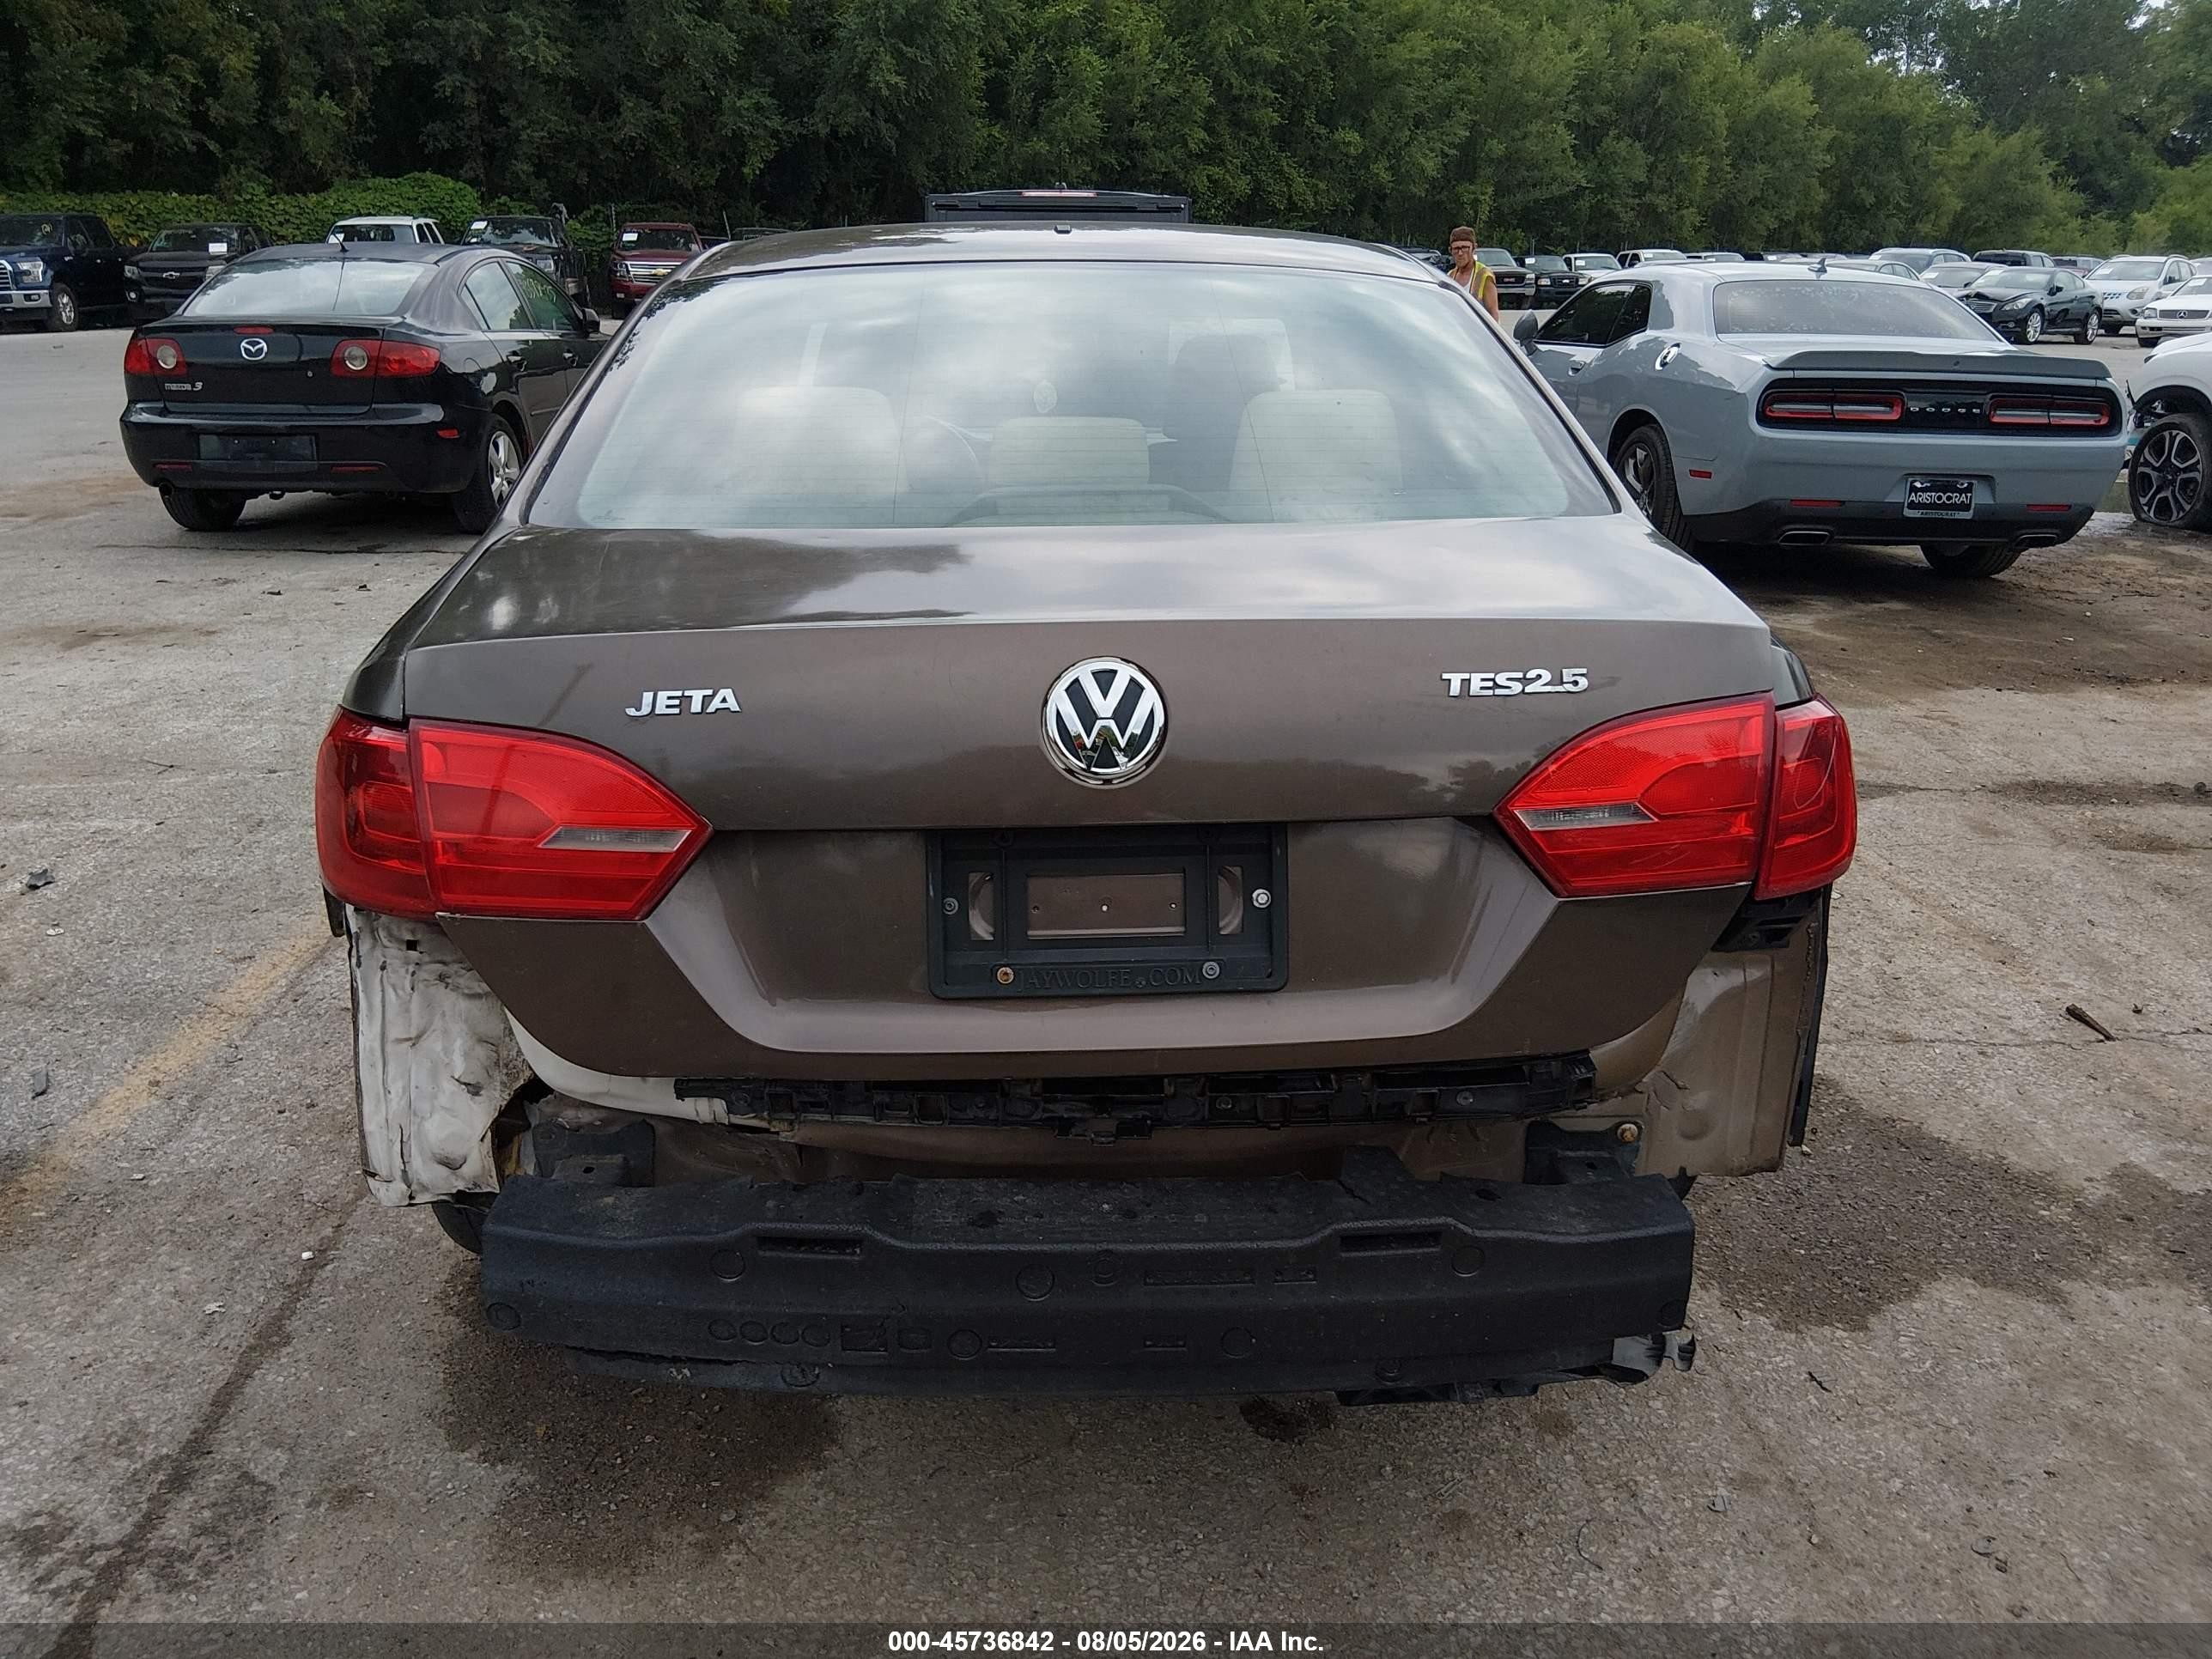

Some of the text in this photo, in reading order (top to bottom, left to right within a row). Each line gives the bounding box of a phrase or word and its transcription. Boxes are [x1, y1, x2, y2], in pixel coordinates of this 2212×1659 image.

[192, 381, 204, 392] 3
[1908, 492, 1972, 505] ARISTOCRAT
[624, 688, 742, 717] JETA
